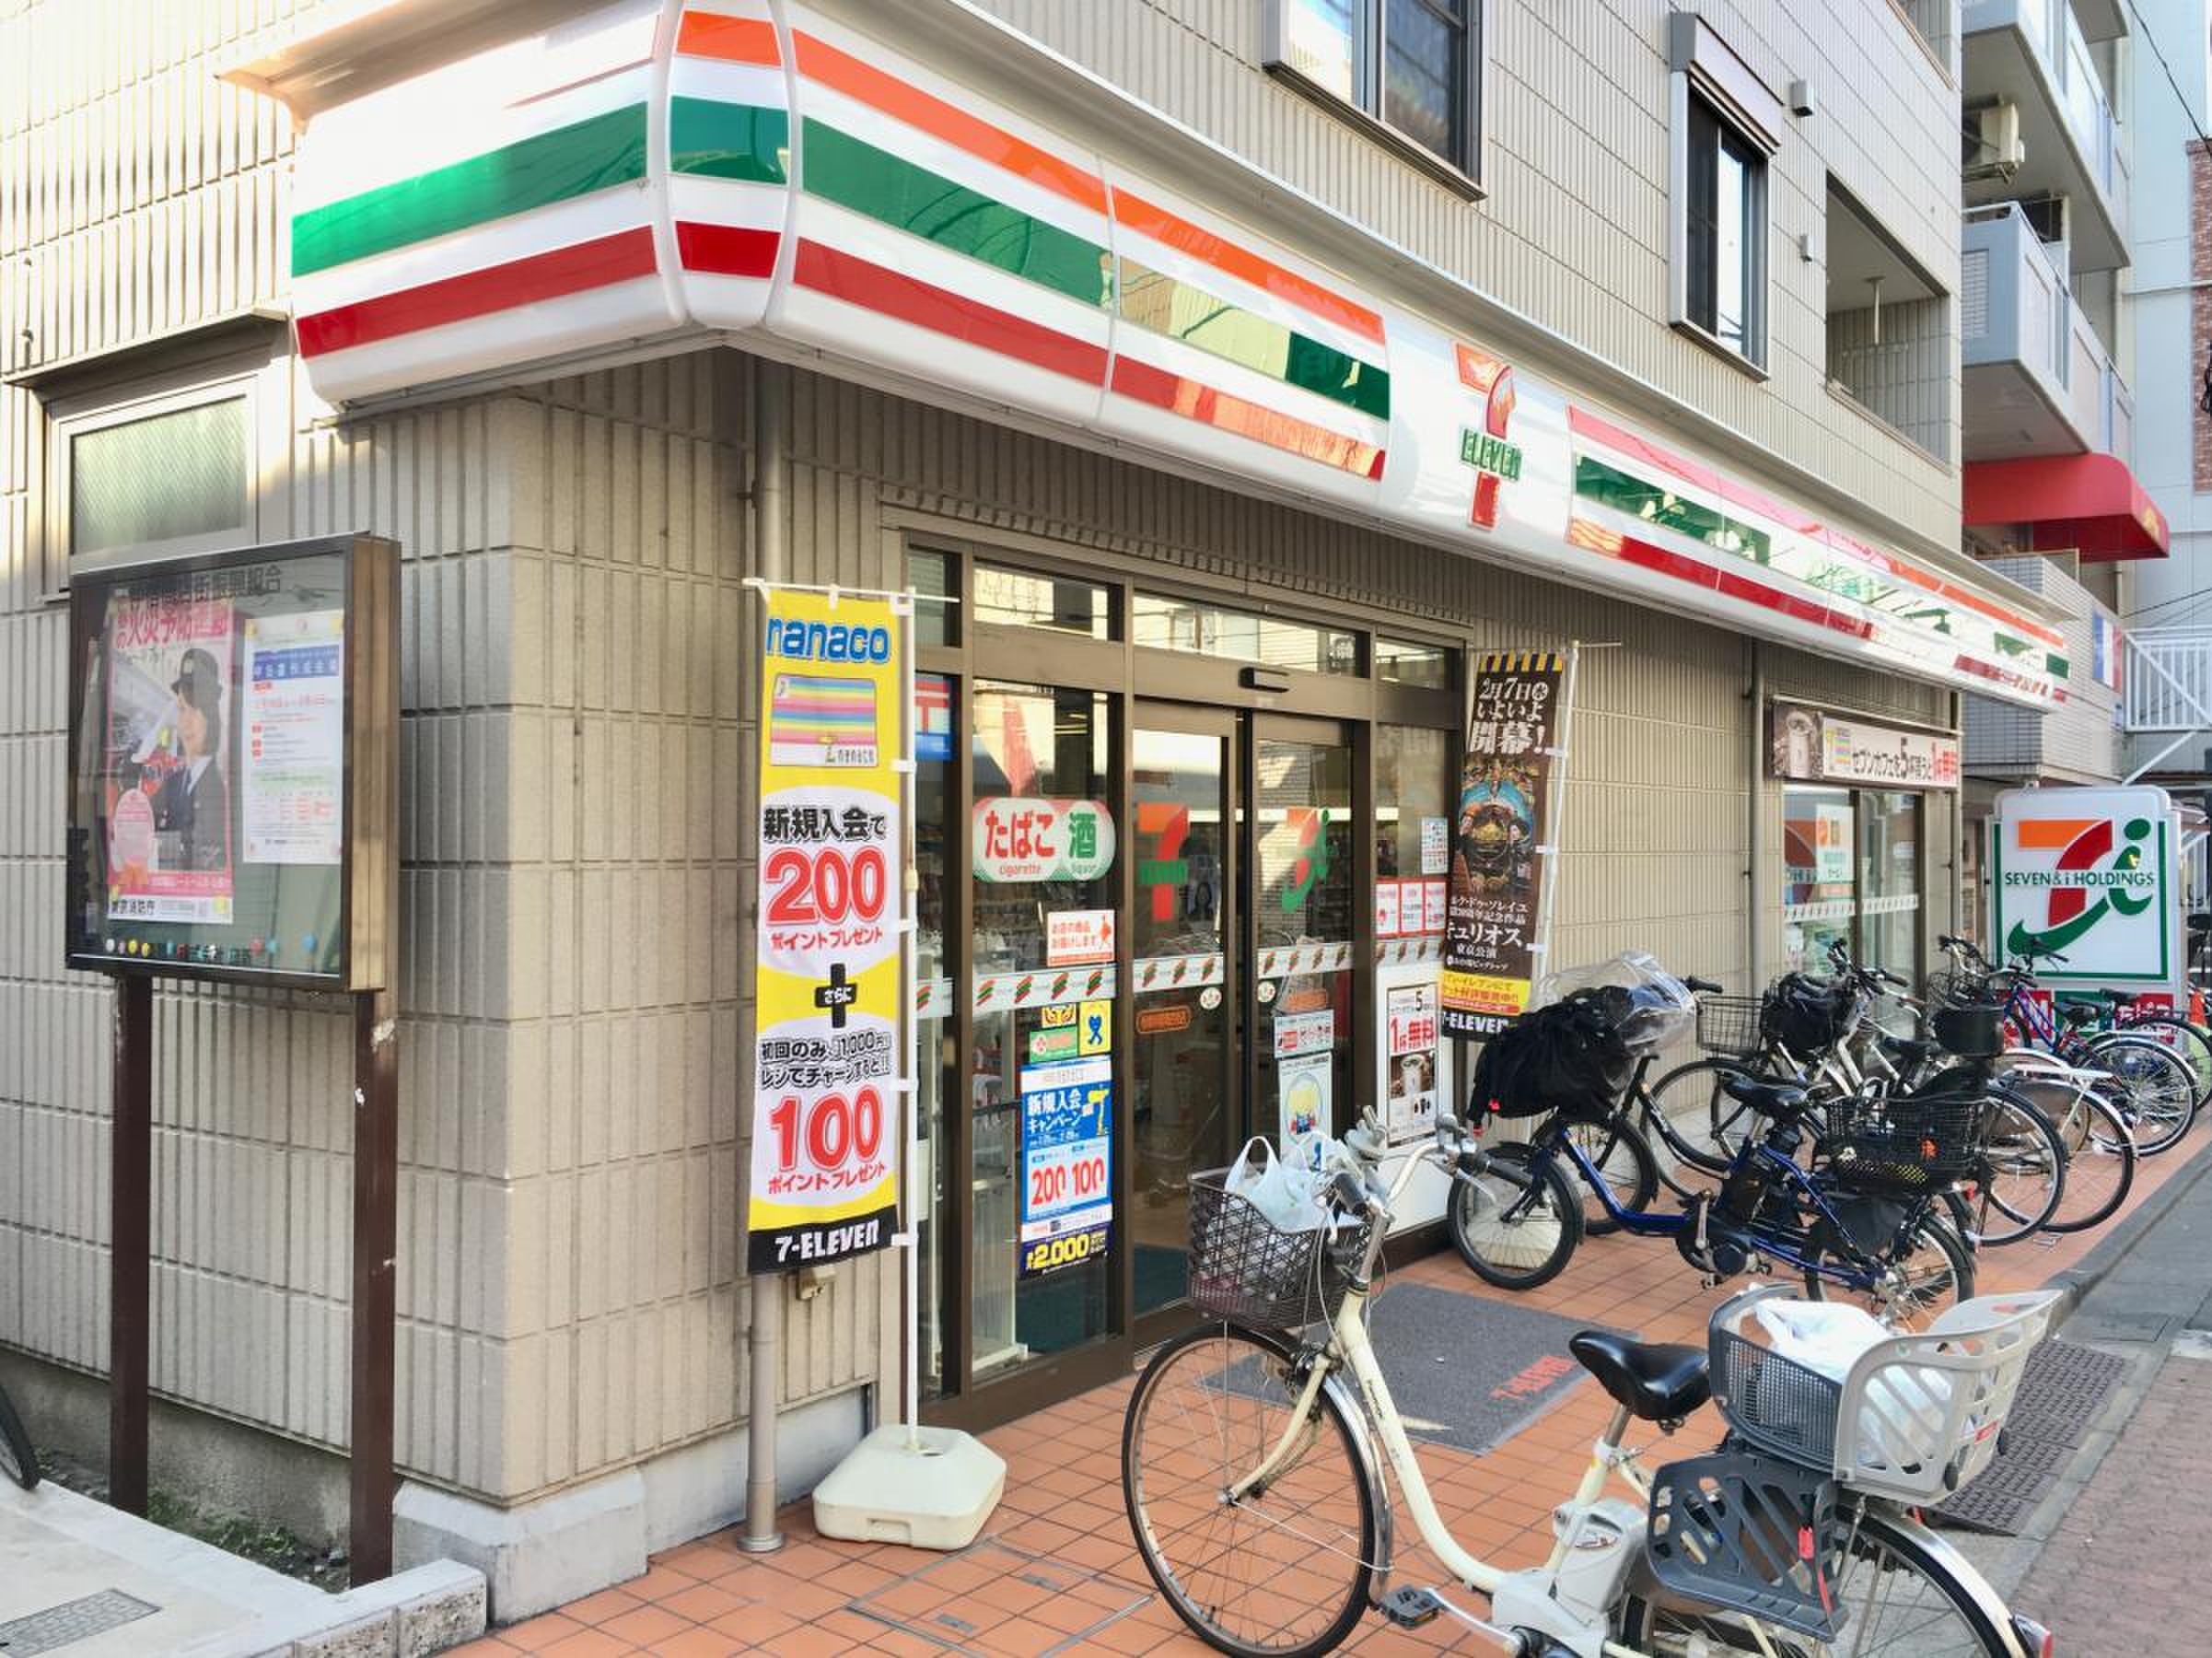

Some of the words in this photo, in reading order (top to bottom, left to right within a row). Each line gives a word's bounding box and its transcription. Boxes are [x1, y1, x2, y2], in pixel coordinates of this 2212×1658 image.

[765, 616, 891, 664] nanaco
[1476, 700, 1543, 722] いよいよ
[763, 805, 887, 843] 新規入会で
[984, 810, 1055, 859] たばこ
[1067, 811, 1097, 859] 酒
[763, 847, 887, 927] 200
[2074, 871, 2155, 887] HOLDINGS
[770, 928, 884, 952] ポイントプレゼント
[821, 986, 853, 1006] さらに
[1027, 1088, 1082, 1115] 新規入会
[769, 1086, 884, 1173] 100
[768, 1163, 886, 1195] ポイントプレゼント
